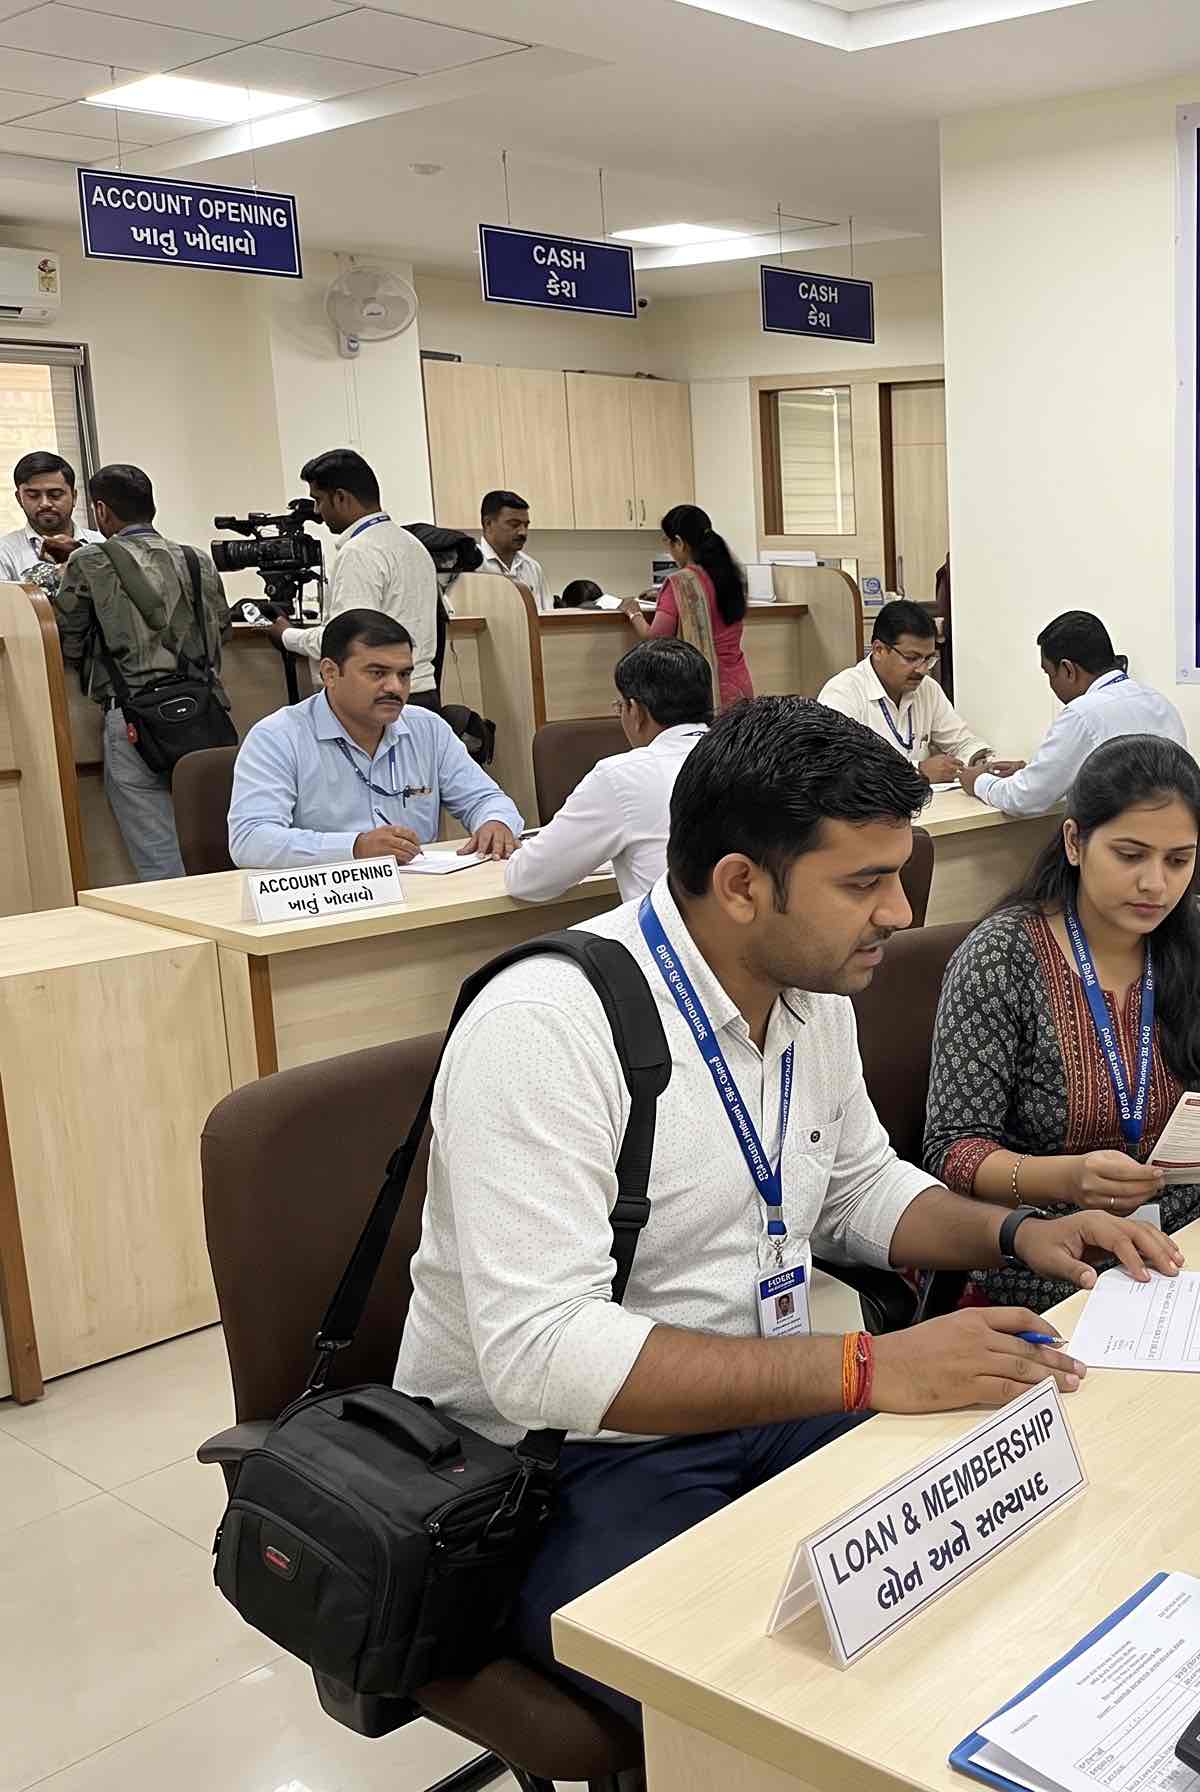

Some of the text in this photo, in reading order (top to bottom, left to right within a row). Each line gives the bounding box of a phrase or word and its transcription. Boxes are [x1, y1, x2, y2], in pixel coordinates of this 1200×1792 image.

[92, 186, 286, 228] ACCOUNT OPENING
[184, 225, 255, 255] ખોલાવો
[533, 246, 585, 270] CASH
[546, 271, 576, 297] કેશ
[799, 282, 838, 303] CASH
[808, 304, 830, 327] કેશ
[260, 865, 392, 894] ACCOUNT OPENING
[324, 886, 373, 905] ખોલાવો
[829, 1408, 1054, 1585] LOAN & MEMBERSHIP
[877, 1471, 1049, 1609] લોન અને સભ્યપદ
